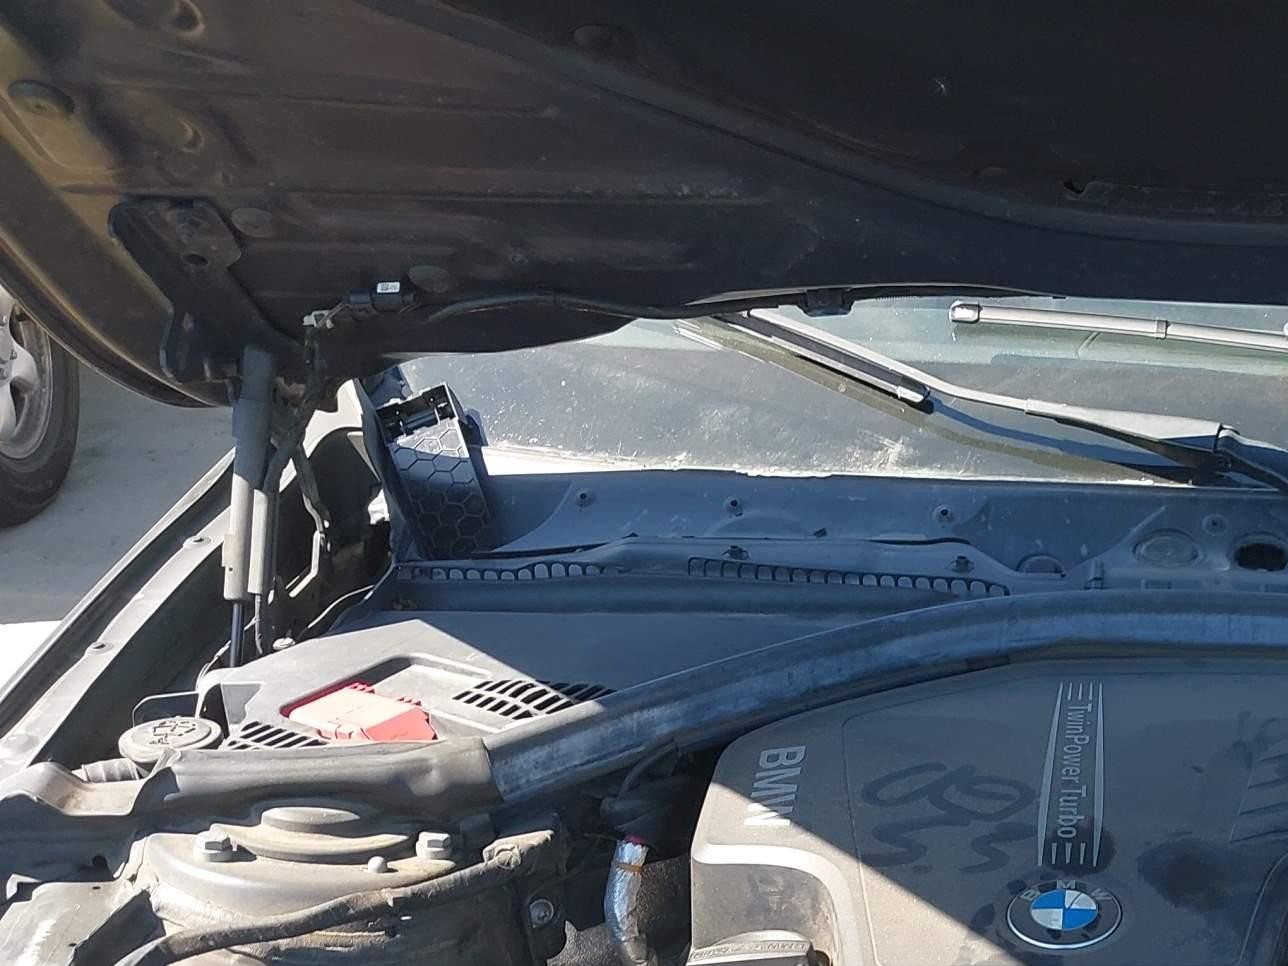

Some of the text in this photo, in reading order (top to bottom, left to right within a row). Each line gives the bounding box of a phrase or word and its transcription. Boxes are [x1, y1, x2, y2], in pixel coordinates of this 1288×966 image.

[743, 745, 807, 827] BMW
[1057, 703, 1093, 839] TwinPower Turbo
[1019, 878, 1113, 899] BMW
